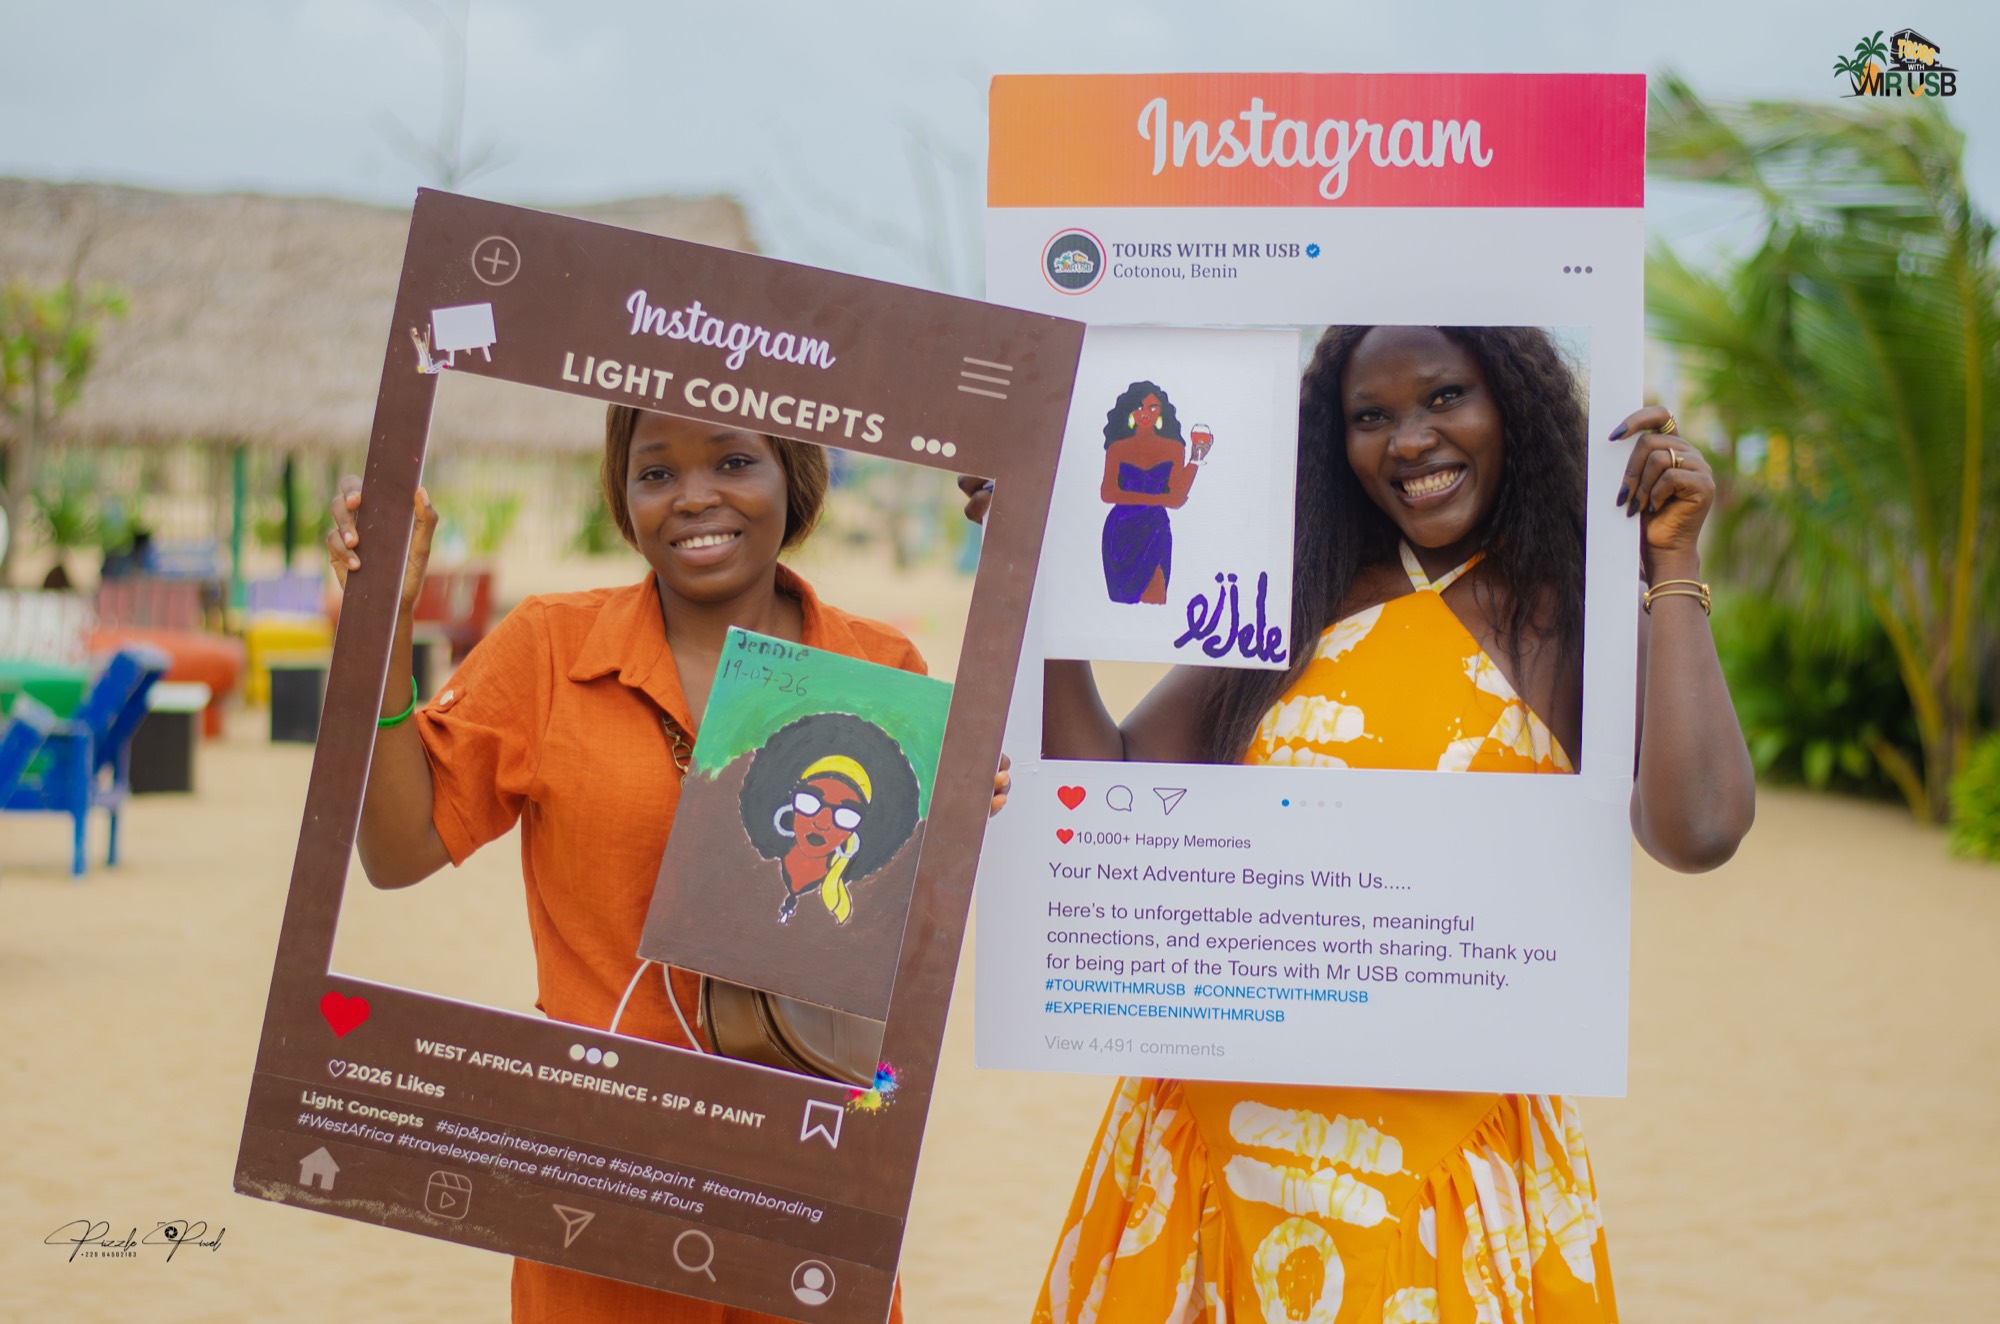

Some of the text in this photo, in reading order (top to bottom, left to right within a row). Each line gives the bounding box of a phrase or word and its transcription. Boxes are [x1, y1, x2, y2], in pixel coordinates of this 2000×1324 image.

[1137, 97, 1493, 200] Instagram
[1112, 243, 1300, 258] TOURS WITH MR USB
[1112, 263, 1238, 280] Cotonou, Benin
[626, 289, 836, 370] Instagram
[562, 352, 886, 444] LIGHT CONCEPTS
[1076, 831, 1251, 849] 10,000+ Happy Memories
[1049, 862, 1091, 880] Your
[1097, 864, 1138, 881] Next
[1143, 866, 1236, 884] Adventure
[1242, 869, 1305, 889] Begins
[1311, 870, 1351, 888] With
[1111, 904, 1128, 919] to
[1134, 905, 1253, 925] unforgettable
[1258, 909, 1366, 929] adventures,
[1372, 915, 1475, 935] meaningful
[1047, 930, 1557, 964] connections, and experiences worth sharing. Thank you
[1046, 953, 1509, 990] for being part of the Tours with Mr USB community.
[1045, 979, 1369, 1003] #TOURWITHMRUSB #CONNECTWITHMRUSB
[1045, 1001, 1285, 1023] #EXPERIENCEBENINWITHMRUSB
[1045, 1036, 1225, 1057] View 4,491 comments
[347, 1063, 446, 1097] 2026 Likes
[416, 1038, 766, 1128] WEST AFRICA EXPERIENCE SIP & PAINT
[298, 1112, 705, 1214] #WestAfrica #travelexperience #funactivities #Tours
[302, 1090, 824, 1222] Light Concepts #sip&paintexperience #sip&paint #teambonding
